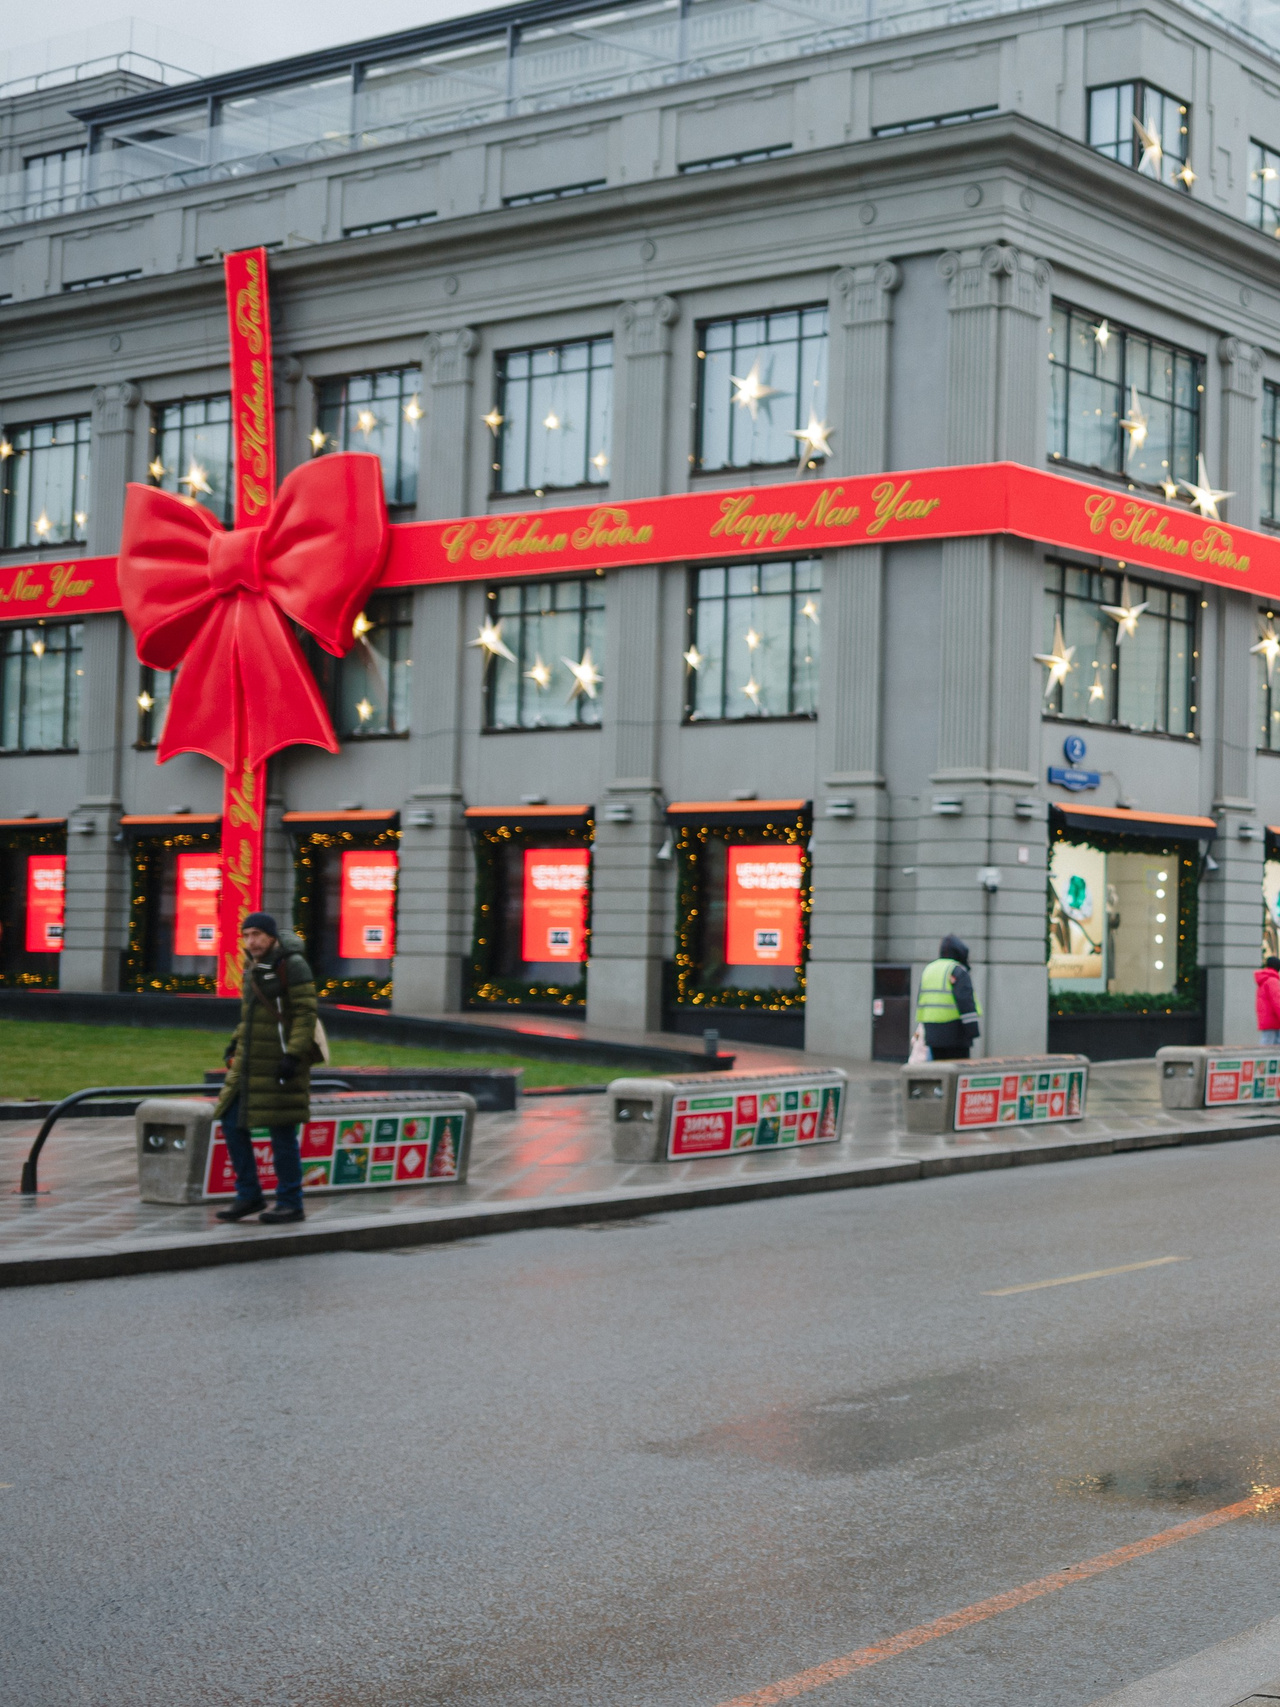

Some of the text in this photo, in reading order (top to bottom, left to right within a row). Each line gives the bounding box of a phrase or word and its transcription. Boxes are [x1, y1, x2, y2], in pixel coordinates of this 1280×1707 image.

[469, 516, 568, 561] Новым
[570, 507, 654, 550] Годом
[710, 480, 940, 546] Happy New Year
[1110, 502, 1189, 557] Новым
[1191, 526, 1250, 572] Годом
[2, 564, 94, 608] New Year
[1073, 739, 1083, 755] 2
[229, 758, 260, 832] Year
[228, 838, 252, 906] New
[683, 1115, 726, 1133] ЗИМА
